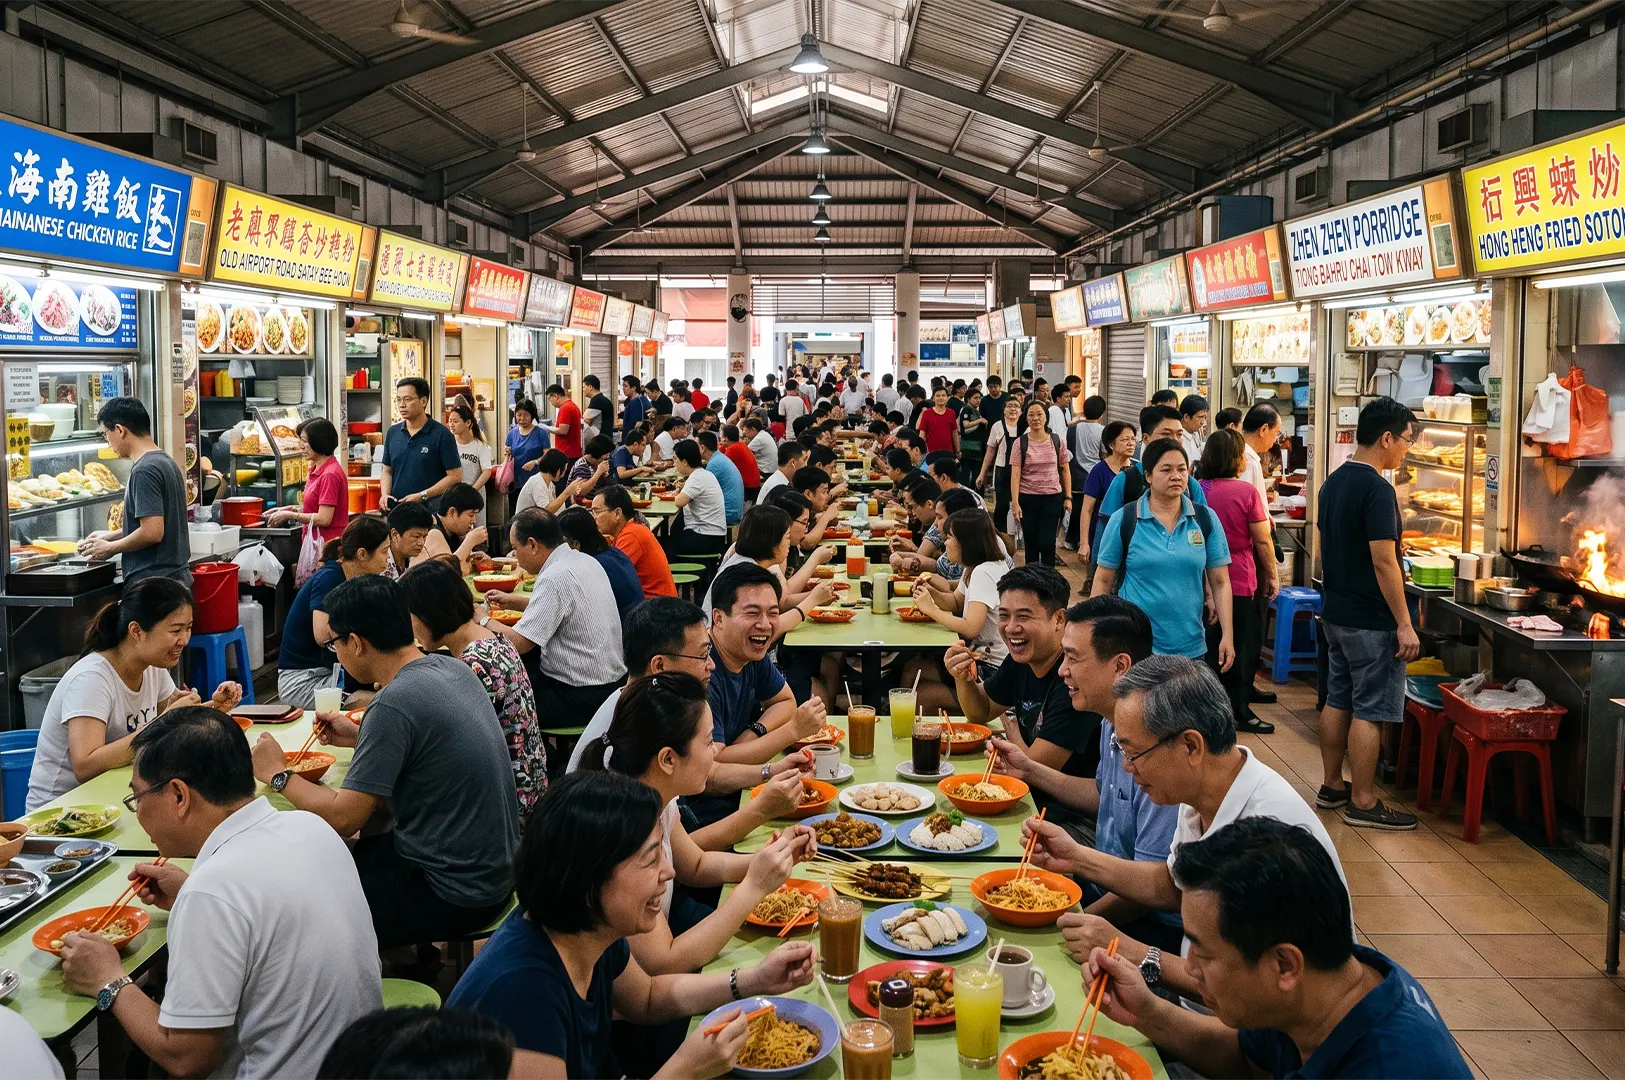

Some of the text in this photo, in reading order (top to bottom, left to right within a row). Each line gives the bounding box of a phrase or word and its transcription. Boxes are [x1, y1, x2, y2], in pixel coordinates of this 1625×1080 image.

[0, 149, 141, 223] 海南雞飯
[66, 221, 115, 247] CHICKEN
[115, 229, 138, 250] RICE
[1290, 199, 1423, 261] ZHEN ZHEN PORRIDGE
[1478, 230, 1510, 259] HONG
[1510, 223, 1543, 255] HENG
[1545, 216, 1581, 249] FRIED
[220, 248, 238, 268] OLD
[239, 253, 275, 275] AIRPORT
[275, 259, 296, 278] ROAD
[297, 263, 319, 281] SATAY
[319, 267, 332, 284] BEE
[1295, 246, 1424, 288] TIONG BAHRU CHAI TOW KWAY
